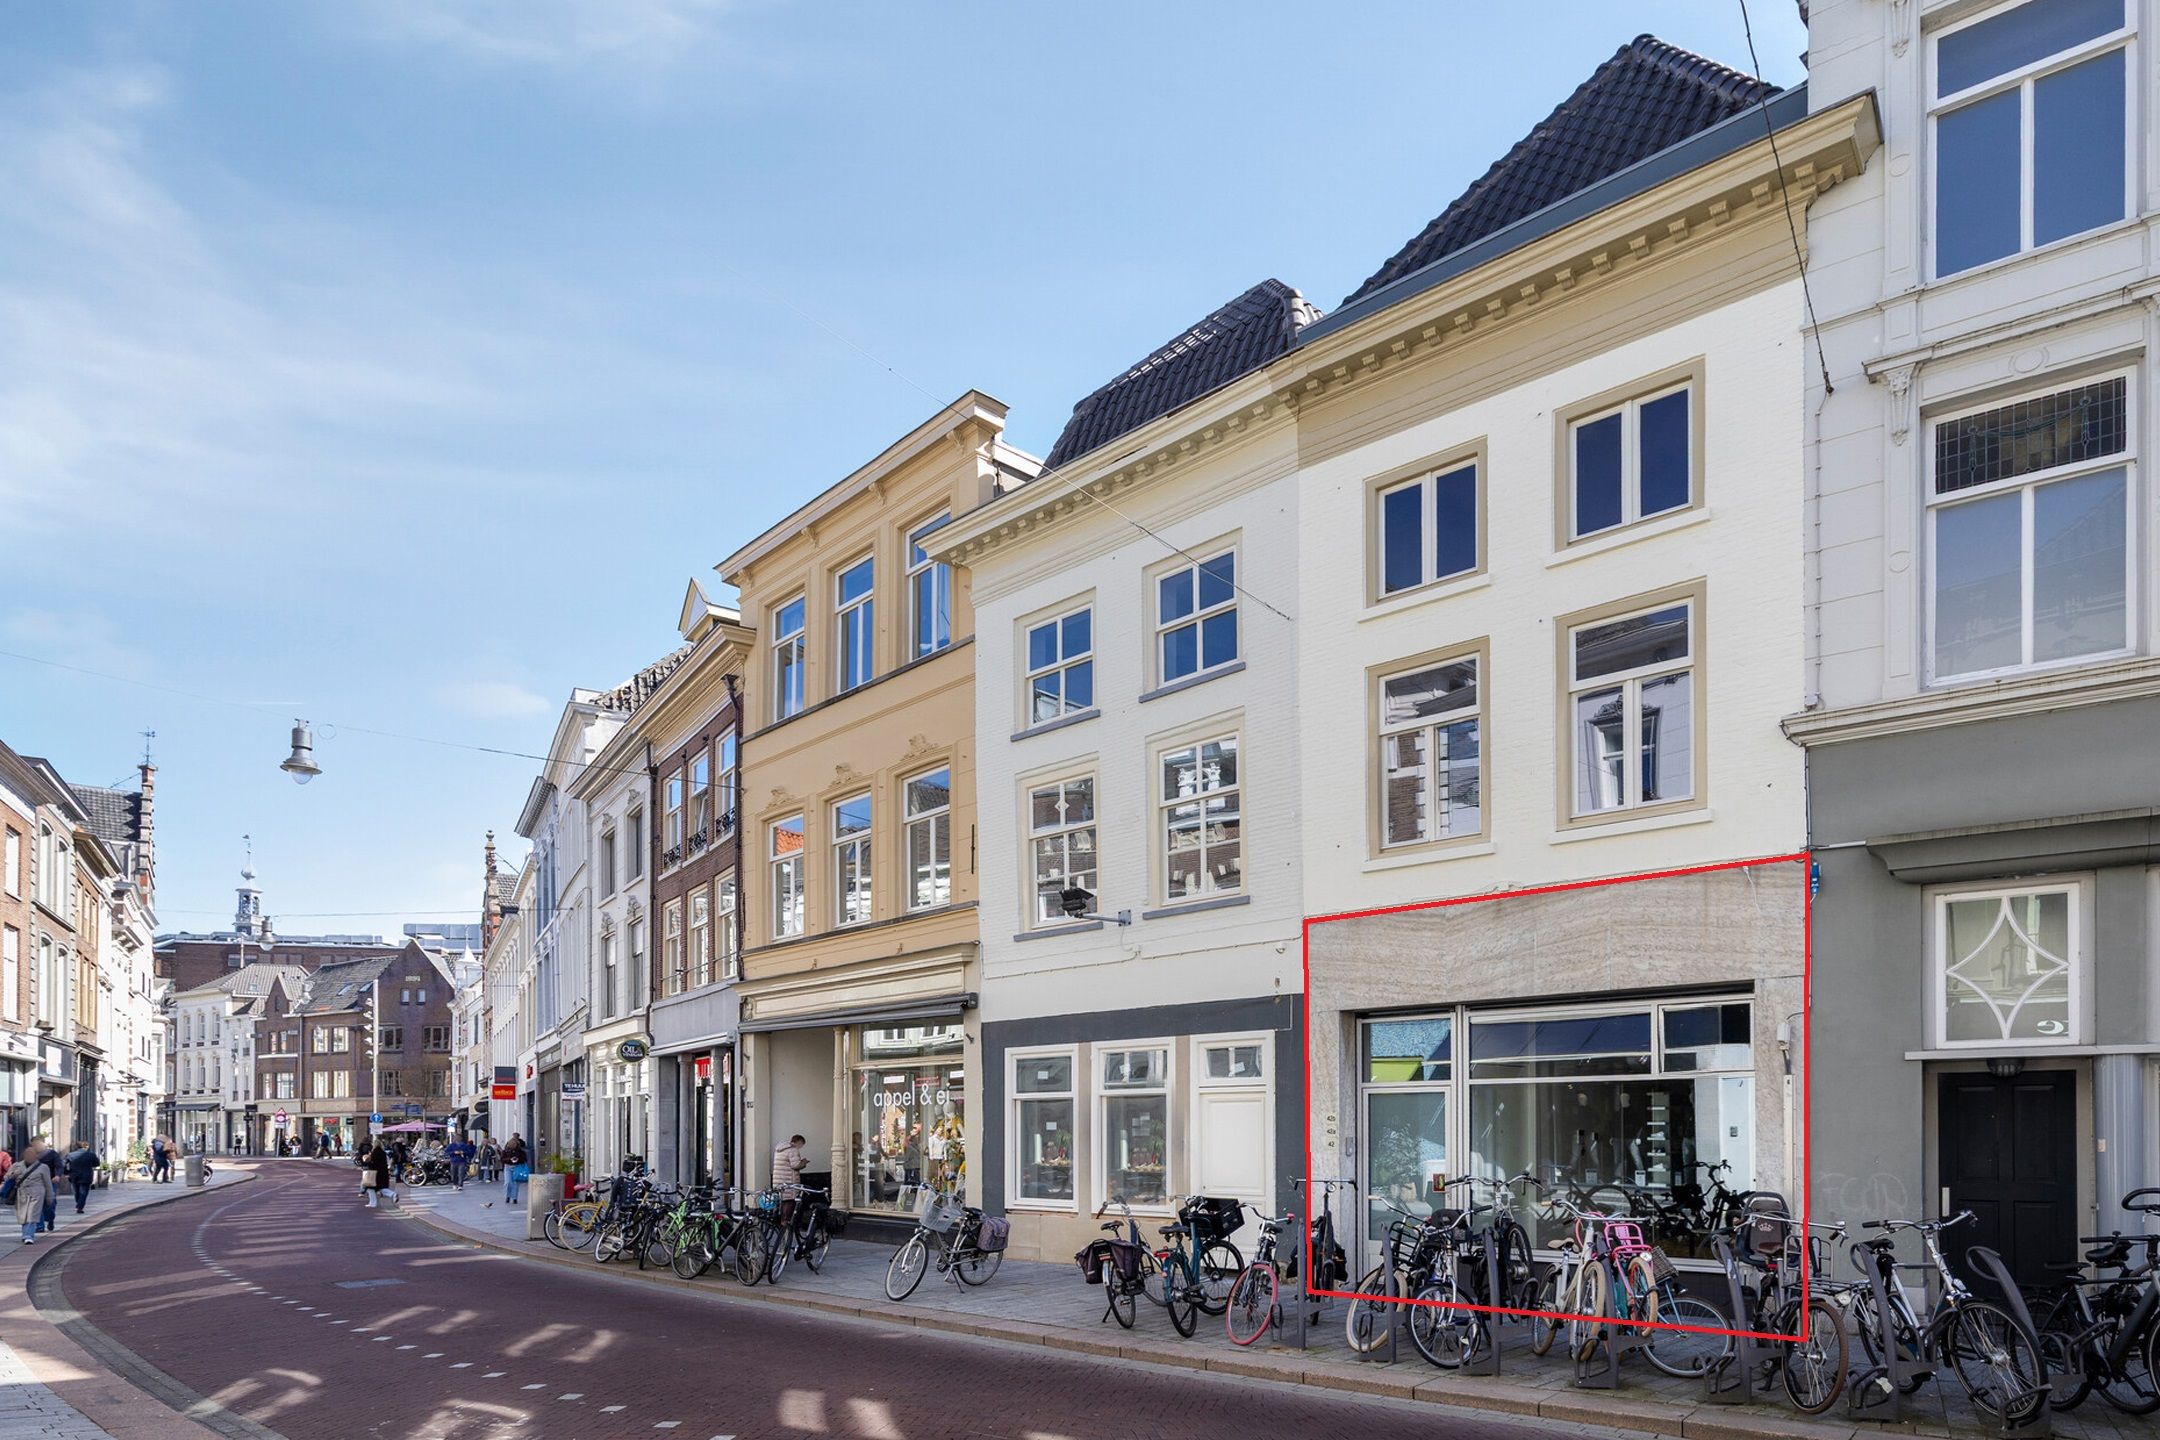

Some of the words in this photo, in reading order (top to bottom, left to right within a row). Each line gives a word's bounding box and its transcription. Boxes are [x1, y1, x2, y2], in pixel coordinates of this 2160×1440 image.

[622, 1045, 637, 1053] OIL
[873, 1080, 915, 1111] appel
[920, 1083, 932, 1105] &
[936, 1082, 950, 1105] ei
